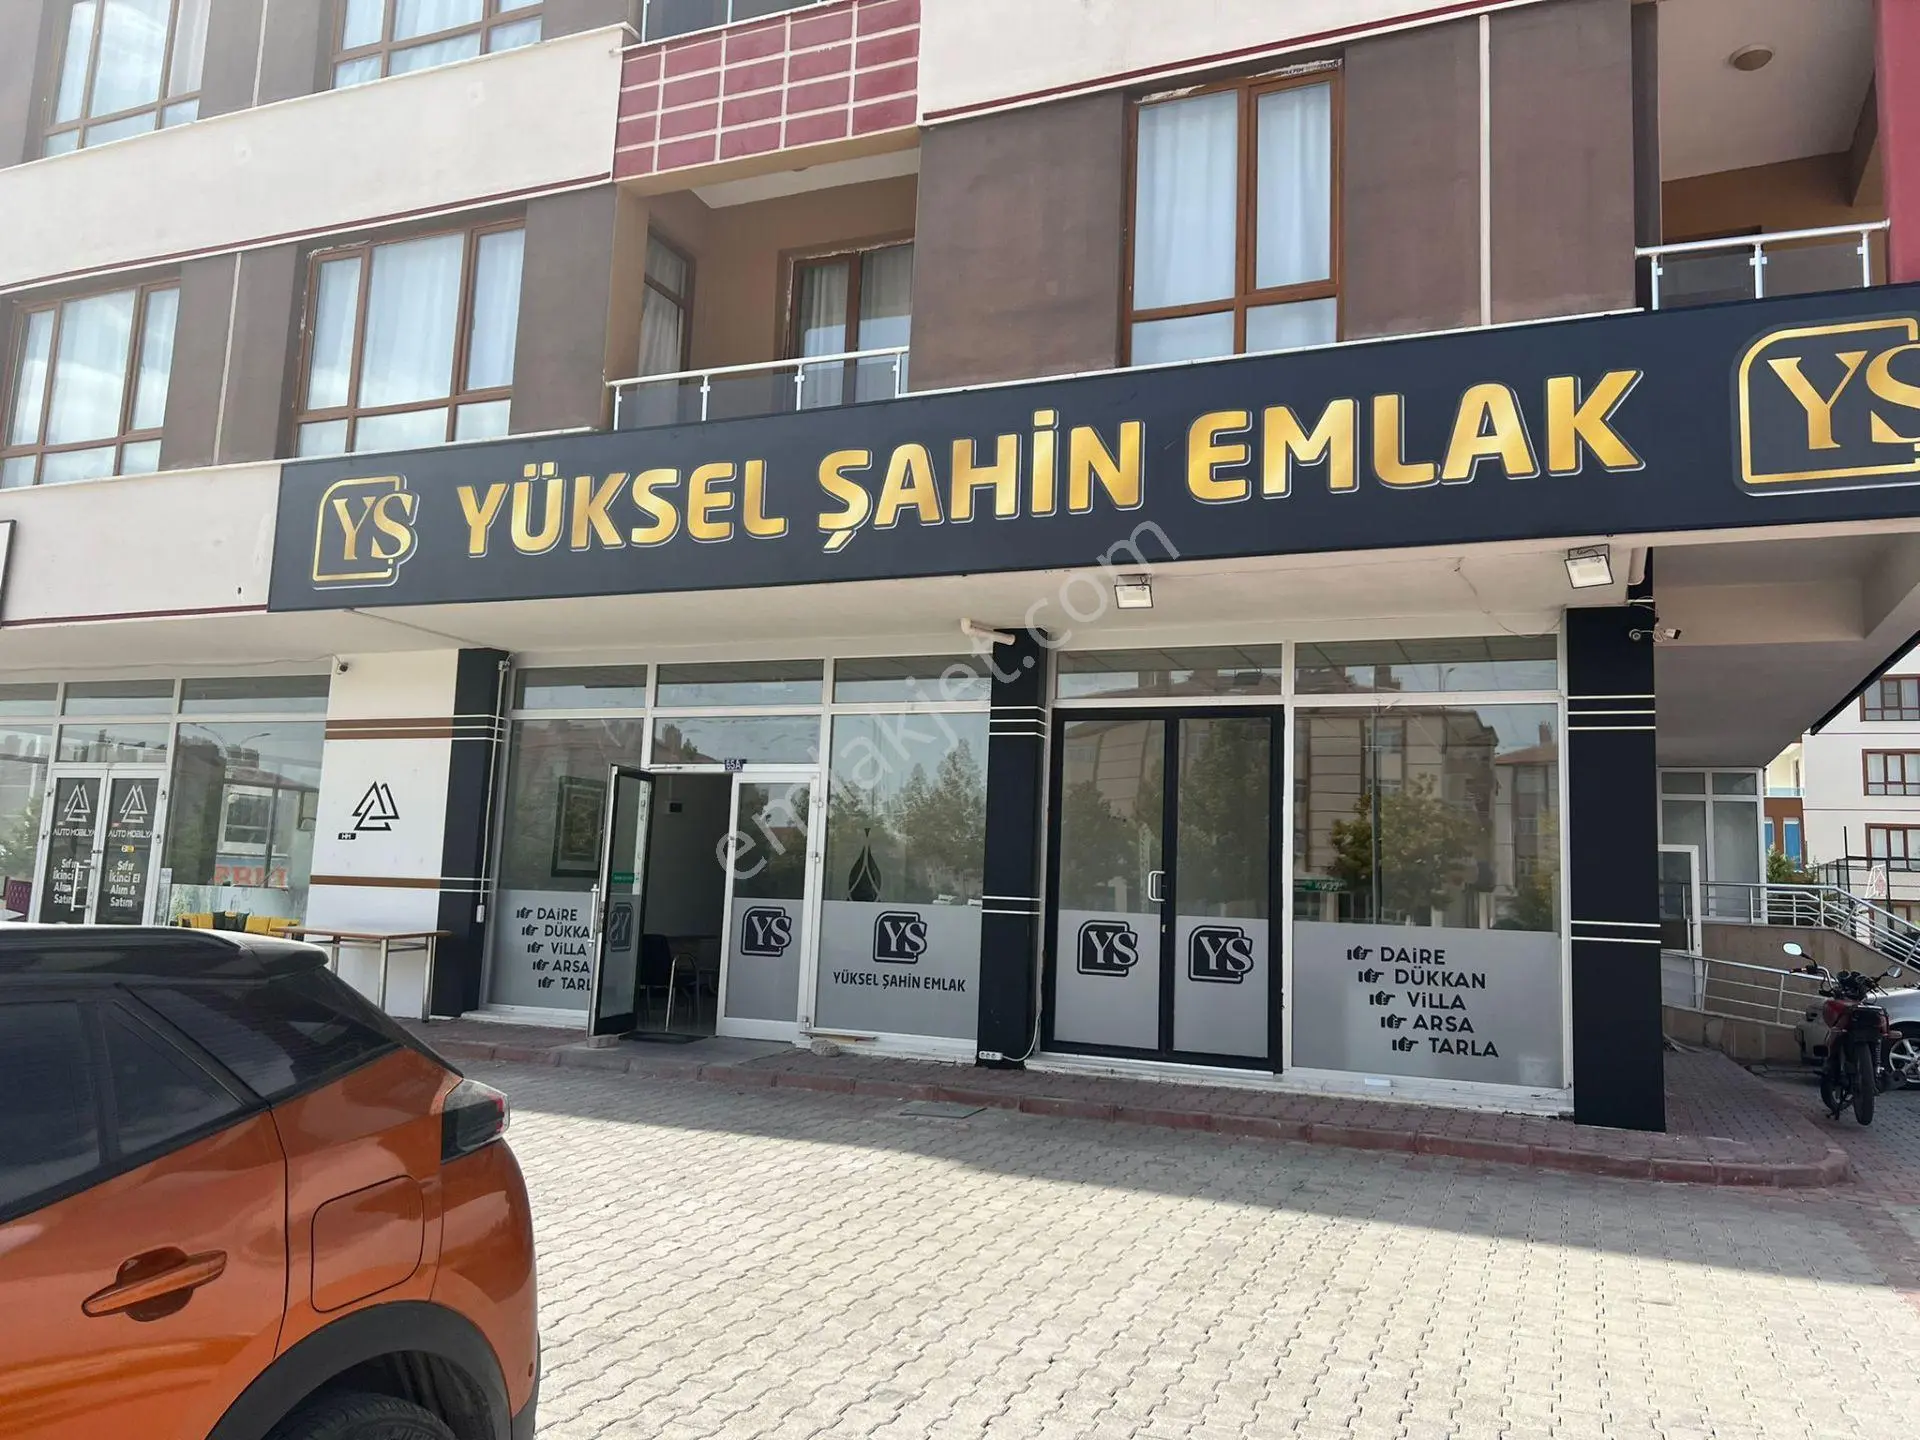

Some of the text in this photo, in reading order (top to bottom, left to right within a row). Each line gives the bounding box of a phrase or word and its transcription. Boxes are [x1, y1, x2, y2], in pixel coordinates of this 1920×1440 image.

[457, 369, 1646, 557] YÜKSEL ŞAHİN EMLAK
[132, 873, 140, 883] El
[110, 896, 133, 907] Satım
[544, 922, 590, 939] DÜKKA
[552, 959, 590, 974] ARSA
[561, 977, 591, 991] TARL
[833, 969, 967, 993] YÜKSEL ŞAHİN EMLAK
[1394, 966, 1486, 989] DÜKKAN
[1412, 1014, 1475, 1034] ARSA
[1428, 1037, 1499, 1058] TARLA
